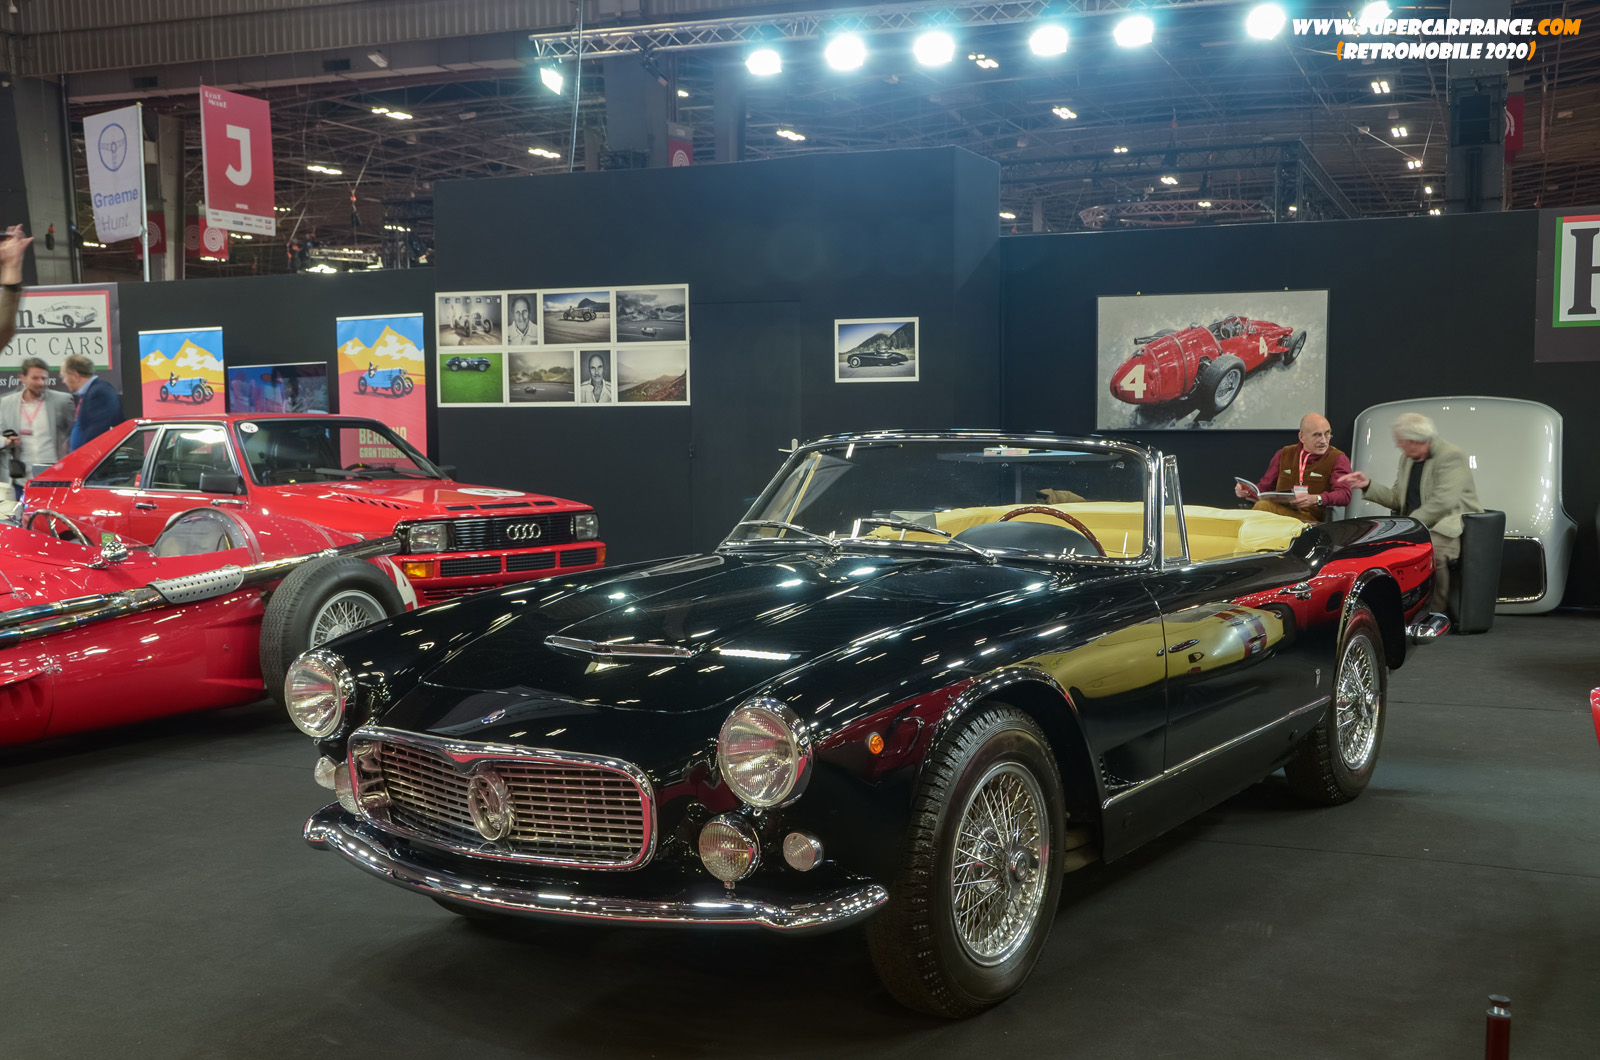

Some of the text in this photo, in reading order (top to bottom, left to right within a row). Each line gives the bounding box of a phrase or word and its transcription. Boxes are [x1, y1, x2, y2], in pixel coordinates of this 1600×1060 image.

[225, 123, 252, 186] J
[93, 187, 139, 209] Graeme
[101, 212, 129, 232] Hunt
[48, 336, 104, 356] CARS
[1258, 336, 1268, 358] 4
[1120, 364, 1147, 399] 4
[359, 447, 377, 458] GRAN
